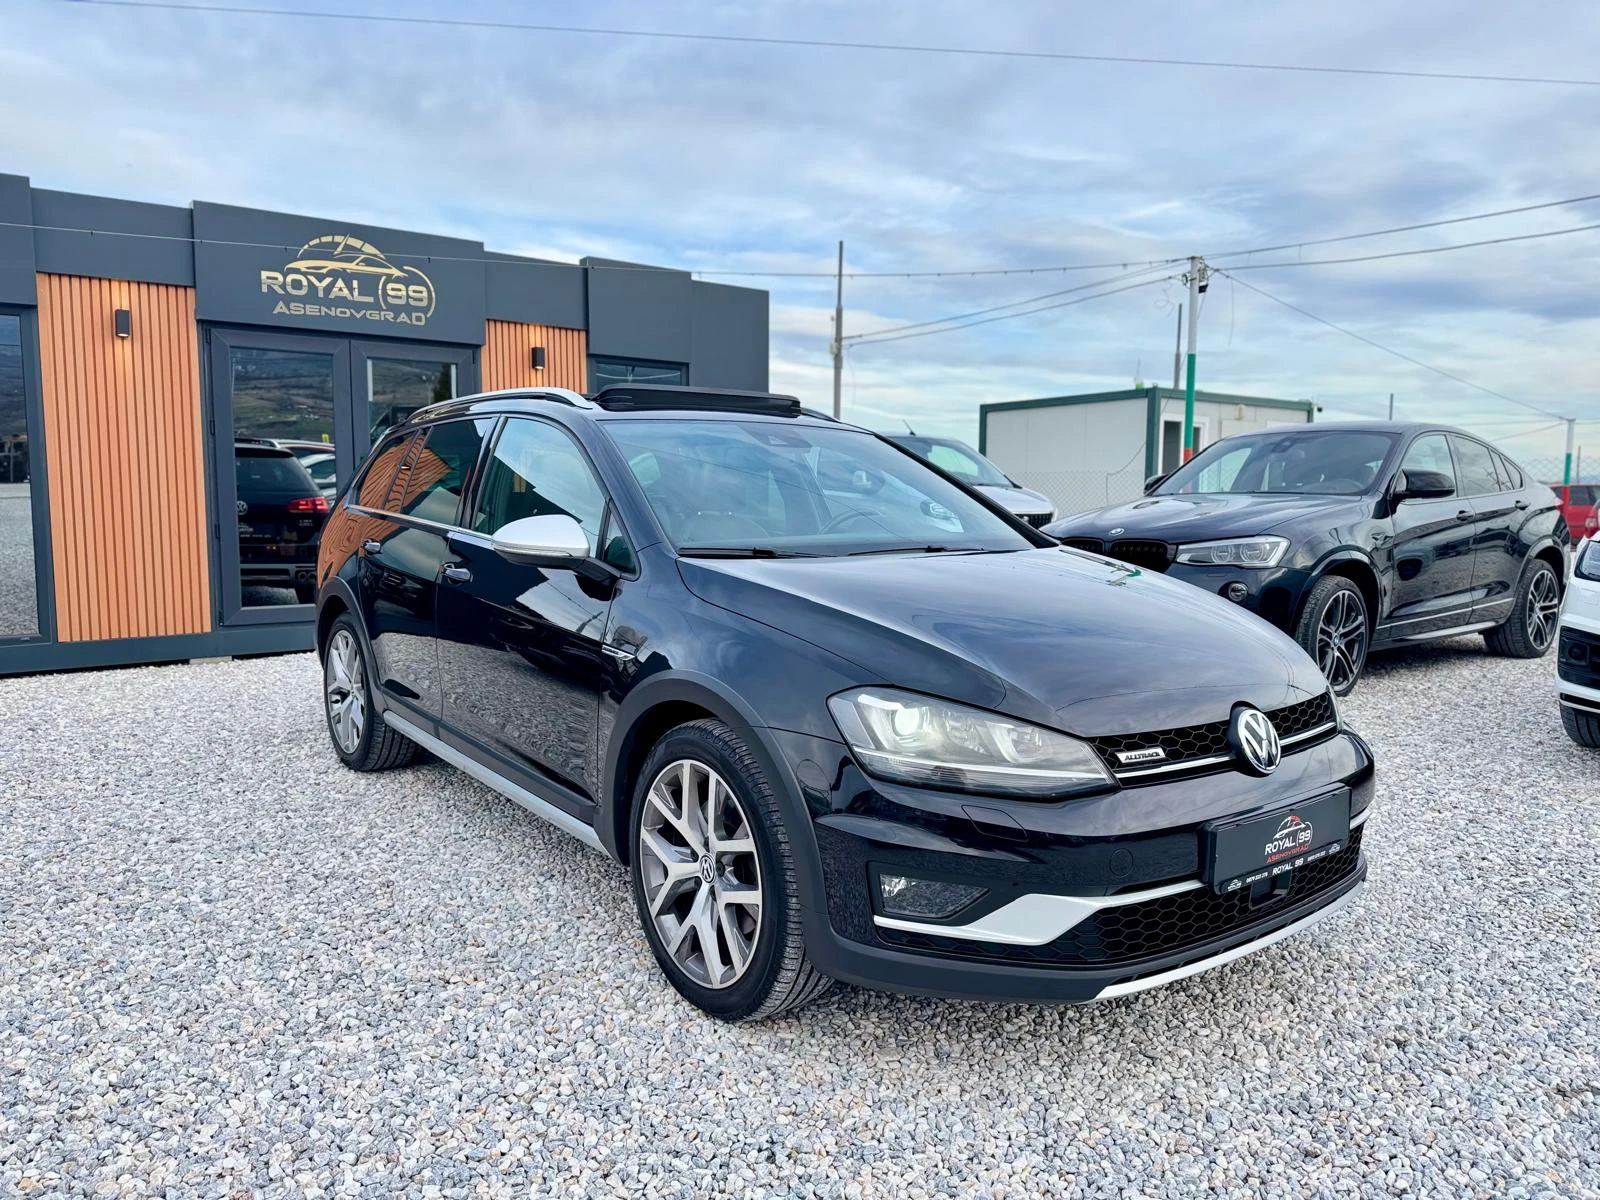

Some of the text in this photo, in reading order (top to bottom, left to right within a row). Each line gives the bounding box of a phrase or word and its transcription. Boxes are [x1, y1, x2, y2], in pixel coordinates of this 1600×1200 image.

[260, 270, 374, 303] ROYAL
[272, 300, 426, 326] ASENOVGRAD
[1239, 710, 1280, 773] VW
[1264, 836, 1295, 855] ROYAL
[1272, 862, 1293, 876] ROYAL
